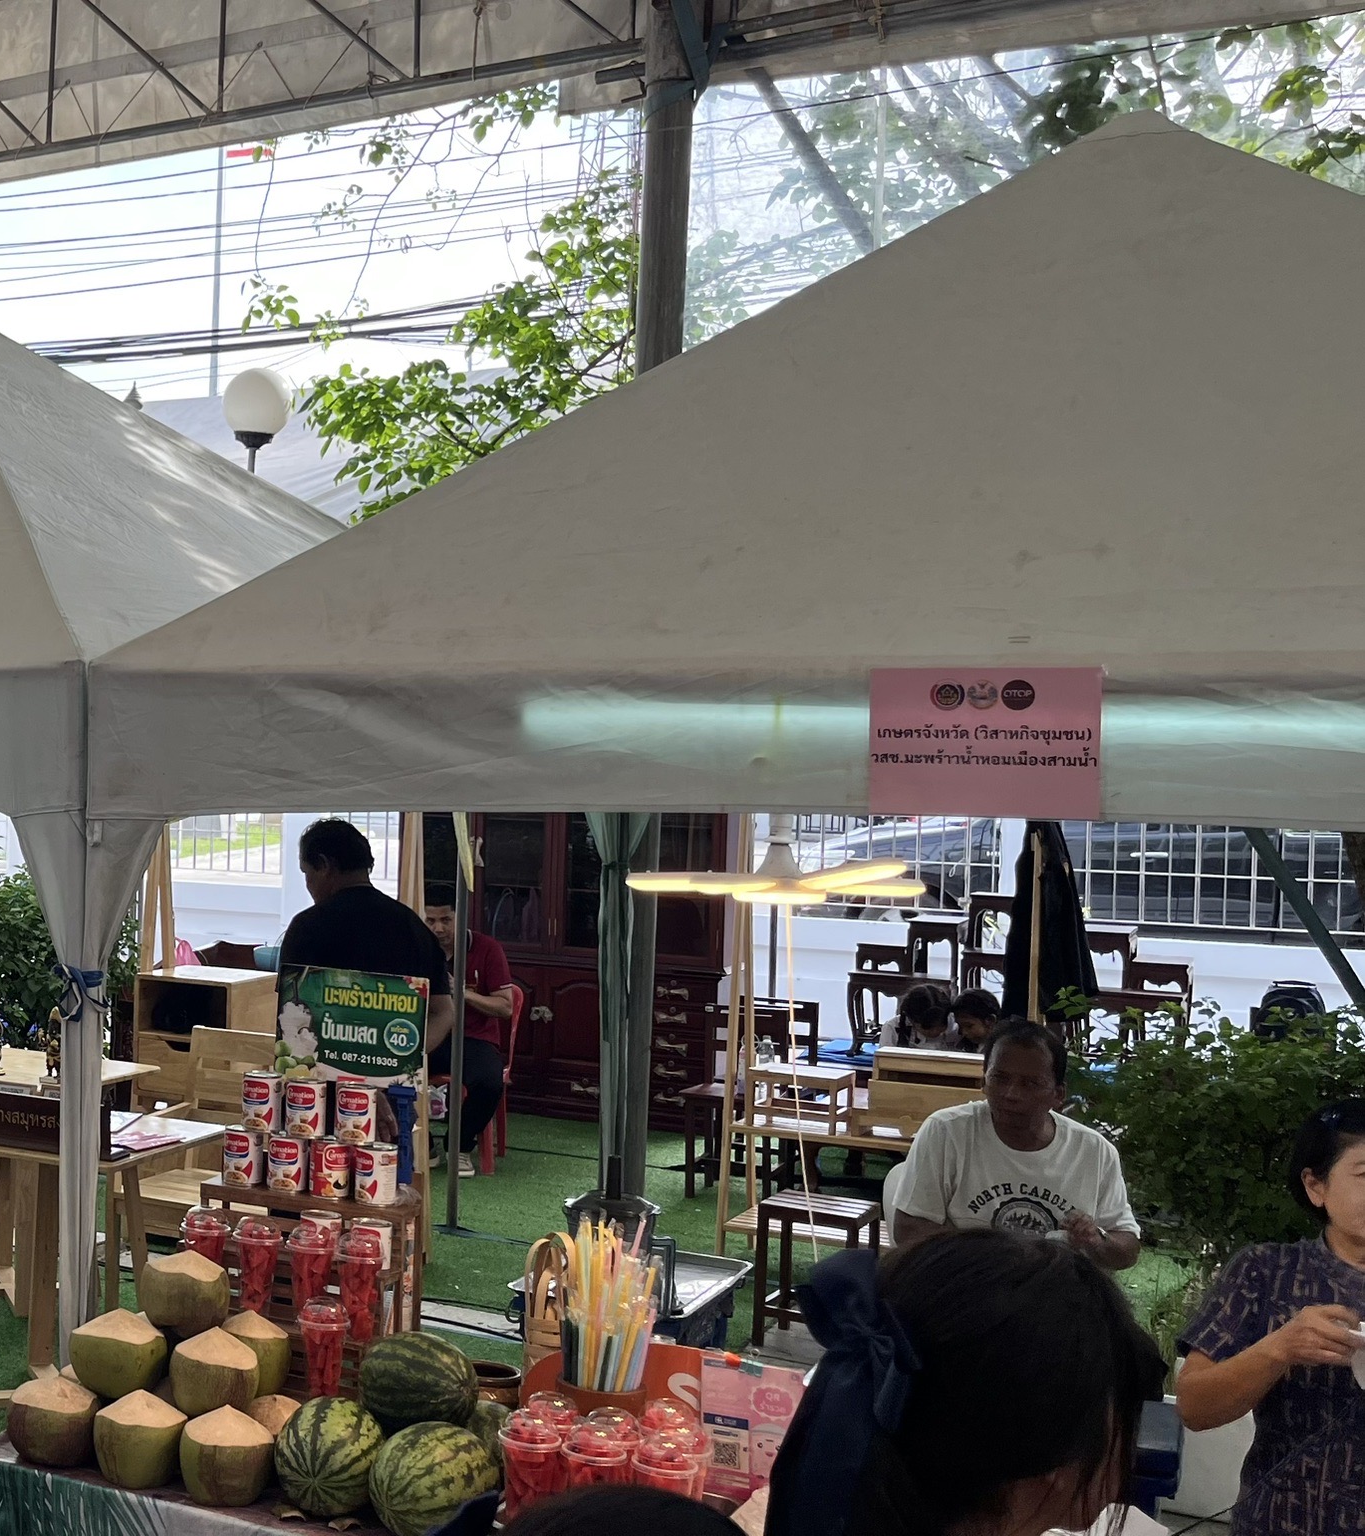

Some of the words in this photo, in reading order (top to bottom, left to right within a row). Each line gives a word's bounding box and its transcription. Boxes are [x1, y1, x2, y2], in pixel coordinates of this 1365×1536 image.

[1003, 688, 1033, 699] OTOP
[877, 724, 970, 741] เกษตรจังหวัด
[974, 724, 1093, 746] (วิสาหกิจชุมชน)
[323, 981, 419, 1013] มะพร้าวน้ำหอม
[321, 1013, 378, 1045] ปั่นนมสด
[389, 1034, 415, 1048] 40.-
[324, 1050, 339, 1061] Tel.
[341, 1053, 398, 1067] 087-2119305
[968, 1183, 1013, 1214] NORTH
